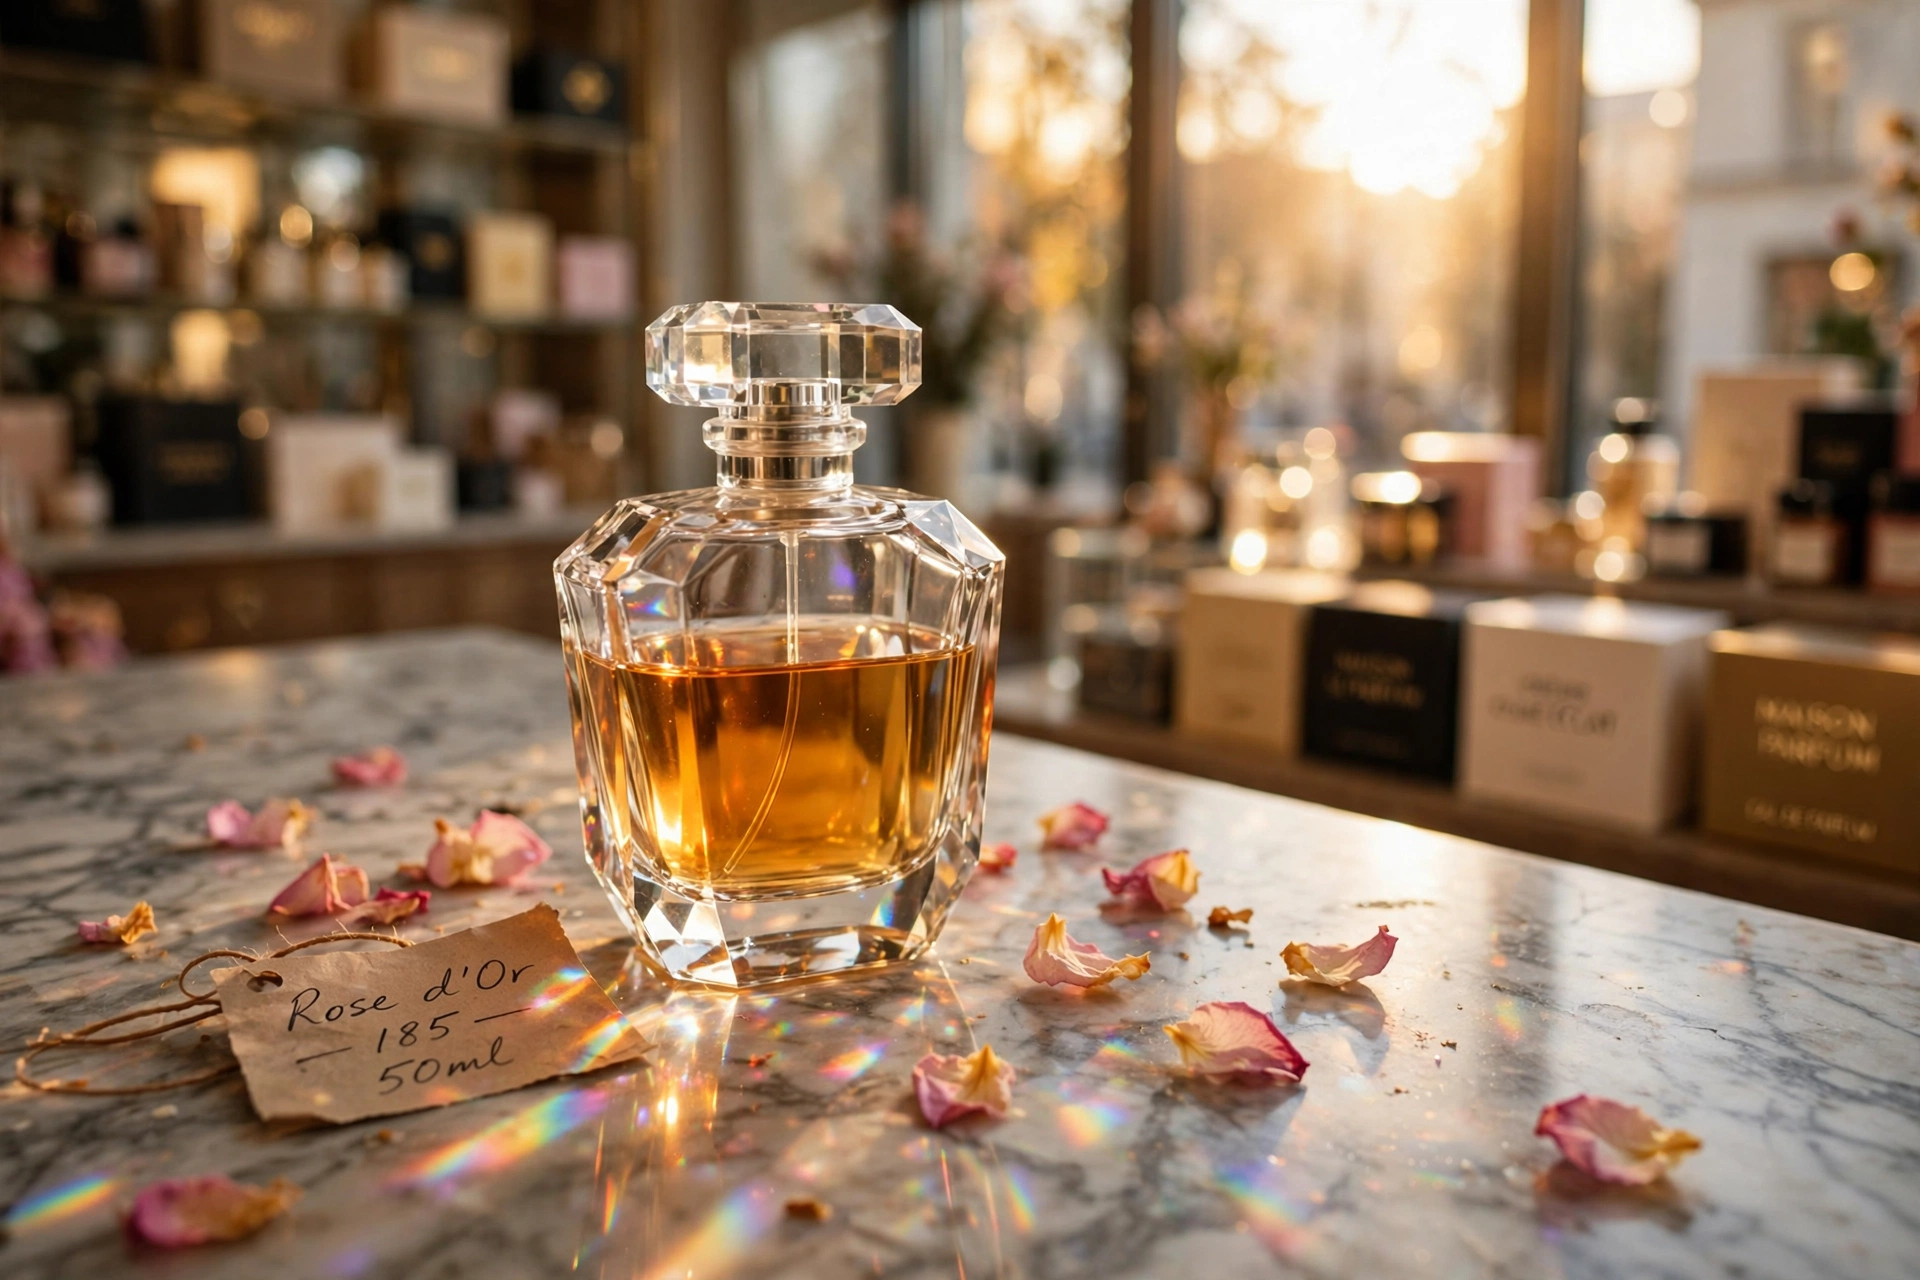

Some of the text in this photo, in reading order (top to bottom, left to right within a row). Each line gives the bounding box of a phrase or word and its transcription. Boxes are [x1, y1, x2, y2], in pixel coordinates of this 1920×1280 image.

[1755, 695, 1878, 740] MAISON
[288, 959, 534, 1032] Rose d'Or
[377, 1011, 459, 1054] 185
[378, 1037, 513, 1096] 50ml
